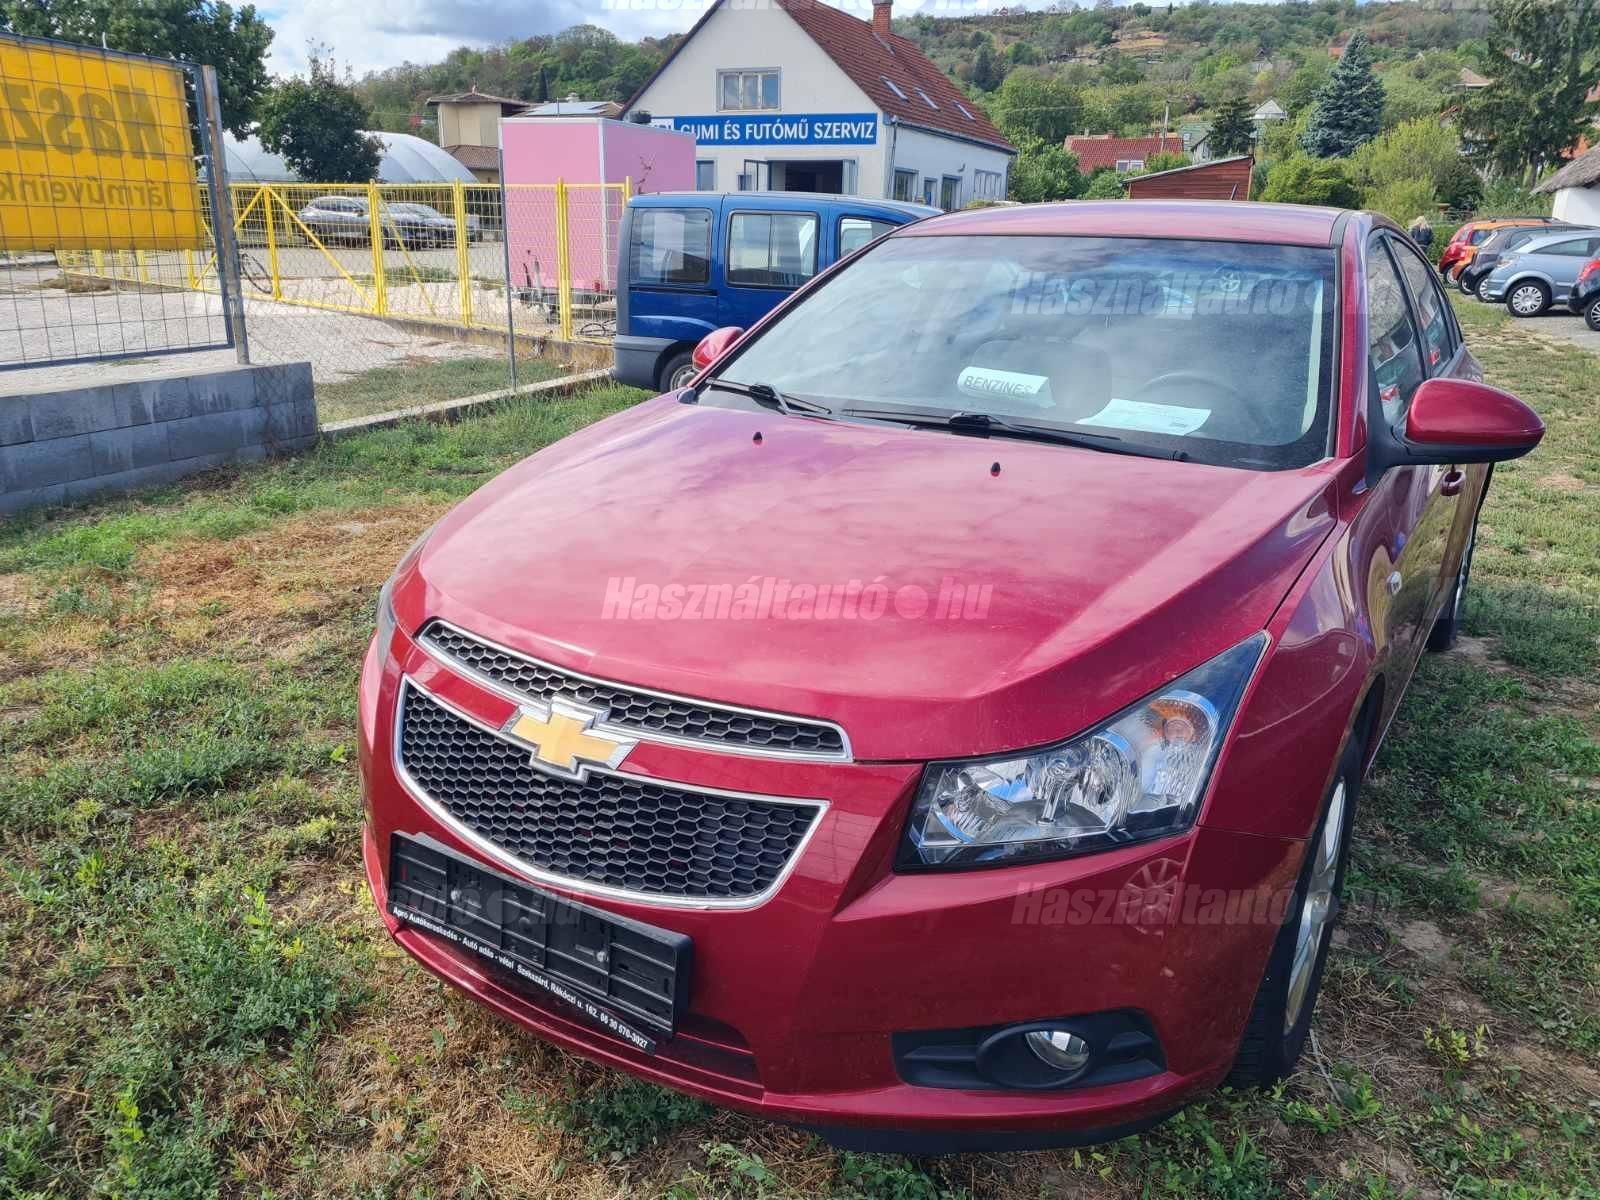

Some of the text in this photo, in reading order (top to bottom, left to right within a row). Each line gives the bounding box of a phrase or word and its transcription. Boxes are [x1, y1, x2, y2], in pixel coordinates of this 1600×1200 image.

[724, 119, 741, 140] ÉS
[745, 118, 809, 140] FUTÓMŰ
[814, 121, 875, 139] SZERVIZ
